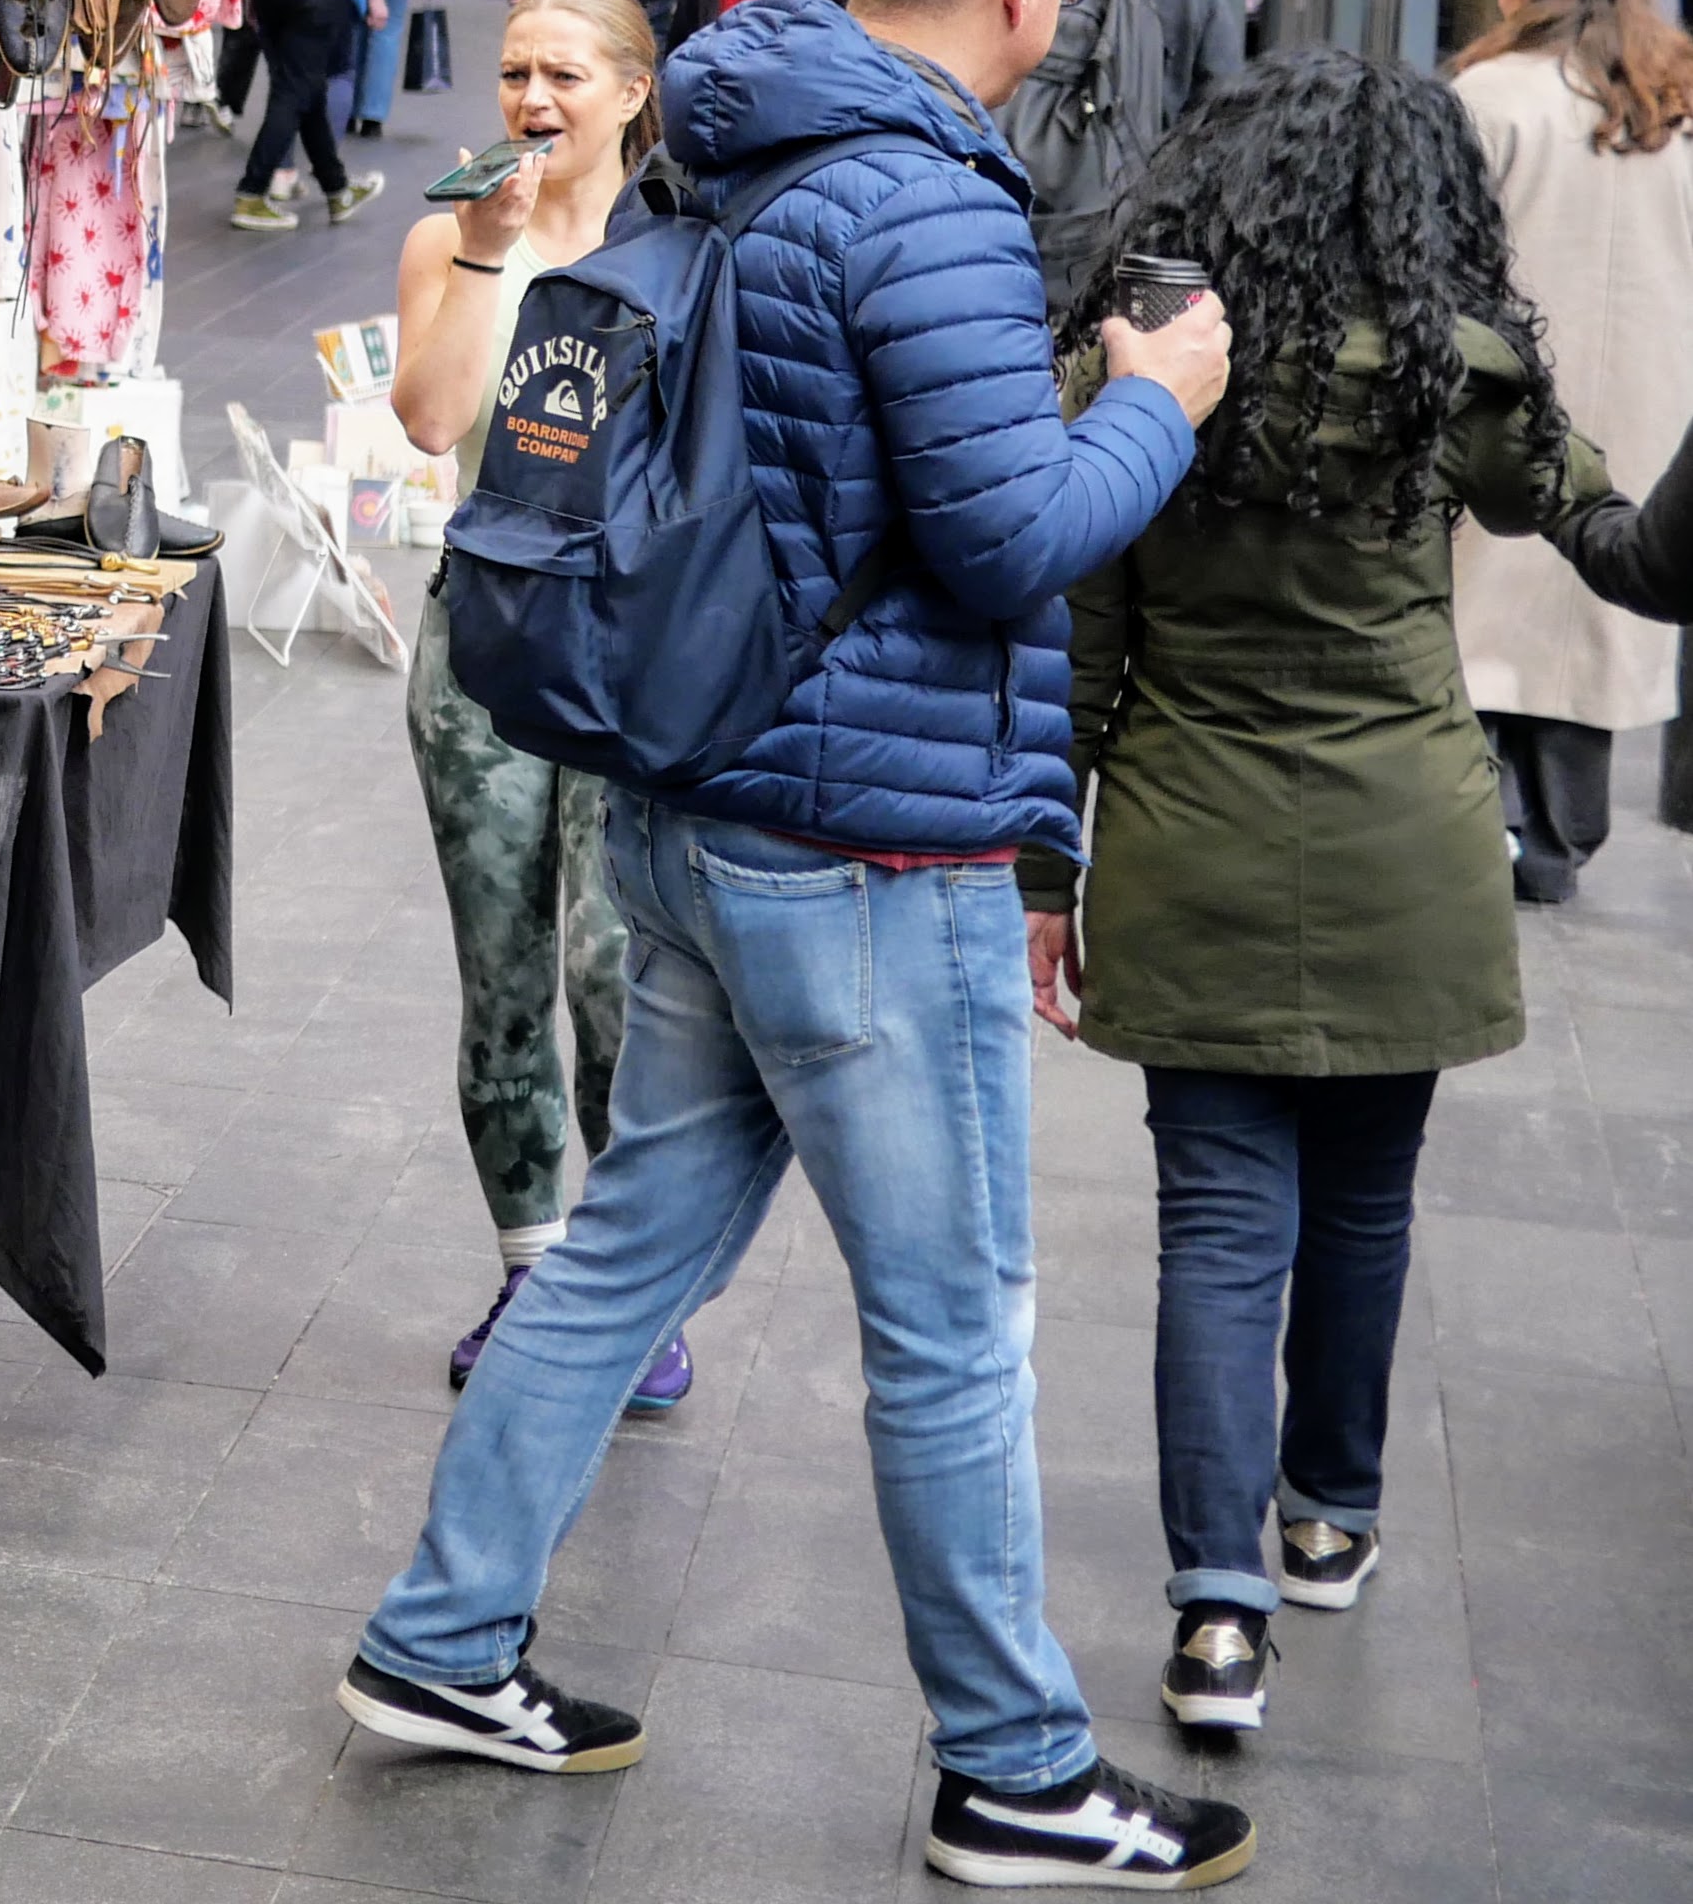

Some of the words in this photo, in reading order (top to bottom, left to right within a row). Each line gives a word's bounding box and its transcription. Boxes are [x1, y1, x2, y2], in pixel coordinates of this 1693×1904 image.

[498, 335, 608, 432] QUIKSILVER
[506, 416, 590, 449] BOARDRIDING
[516, 437, 579, 463] COMPANY
